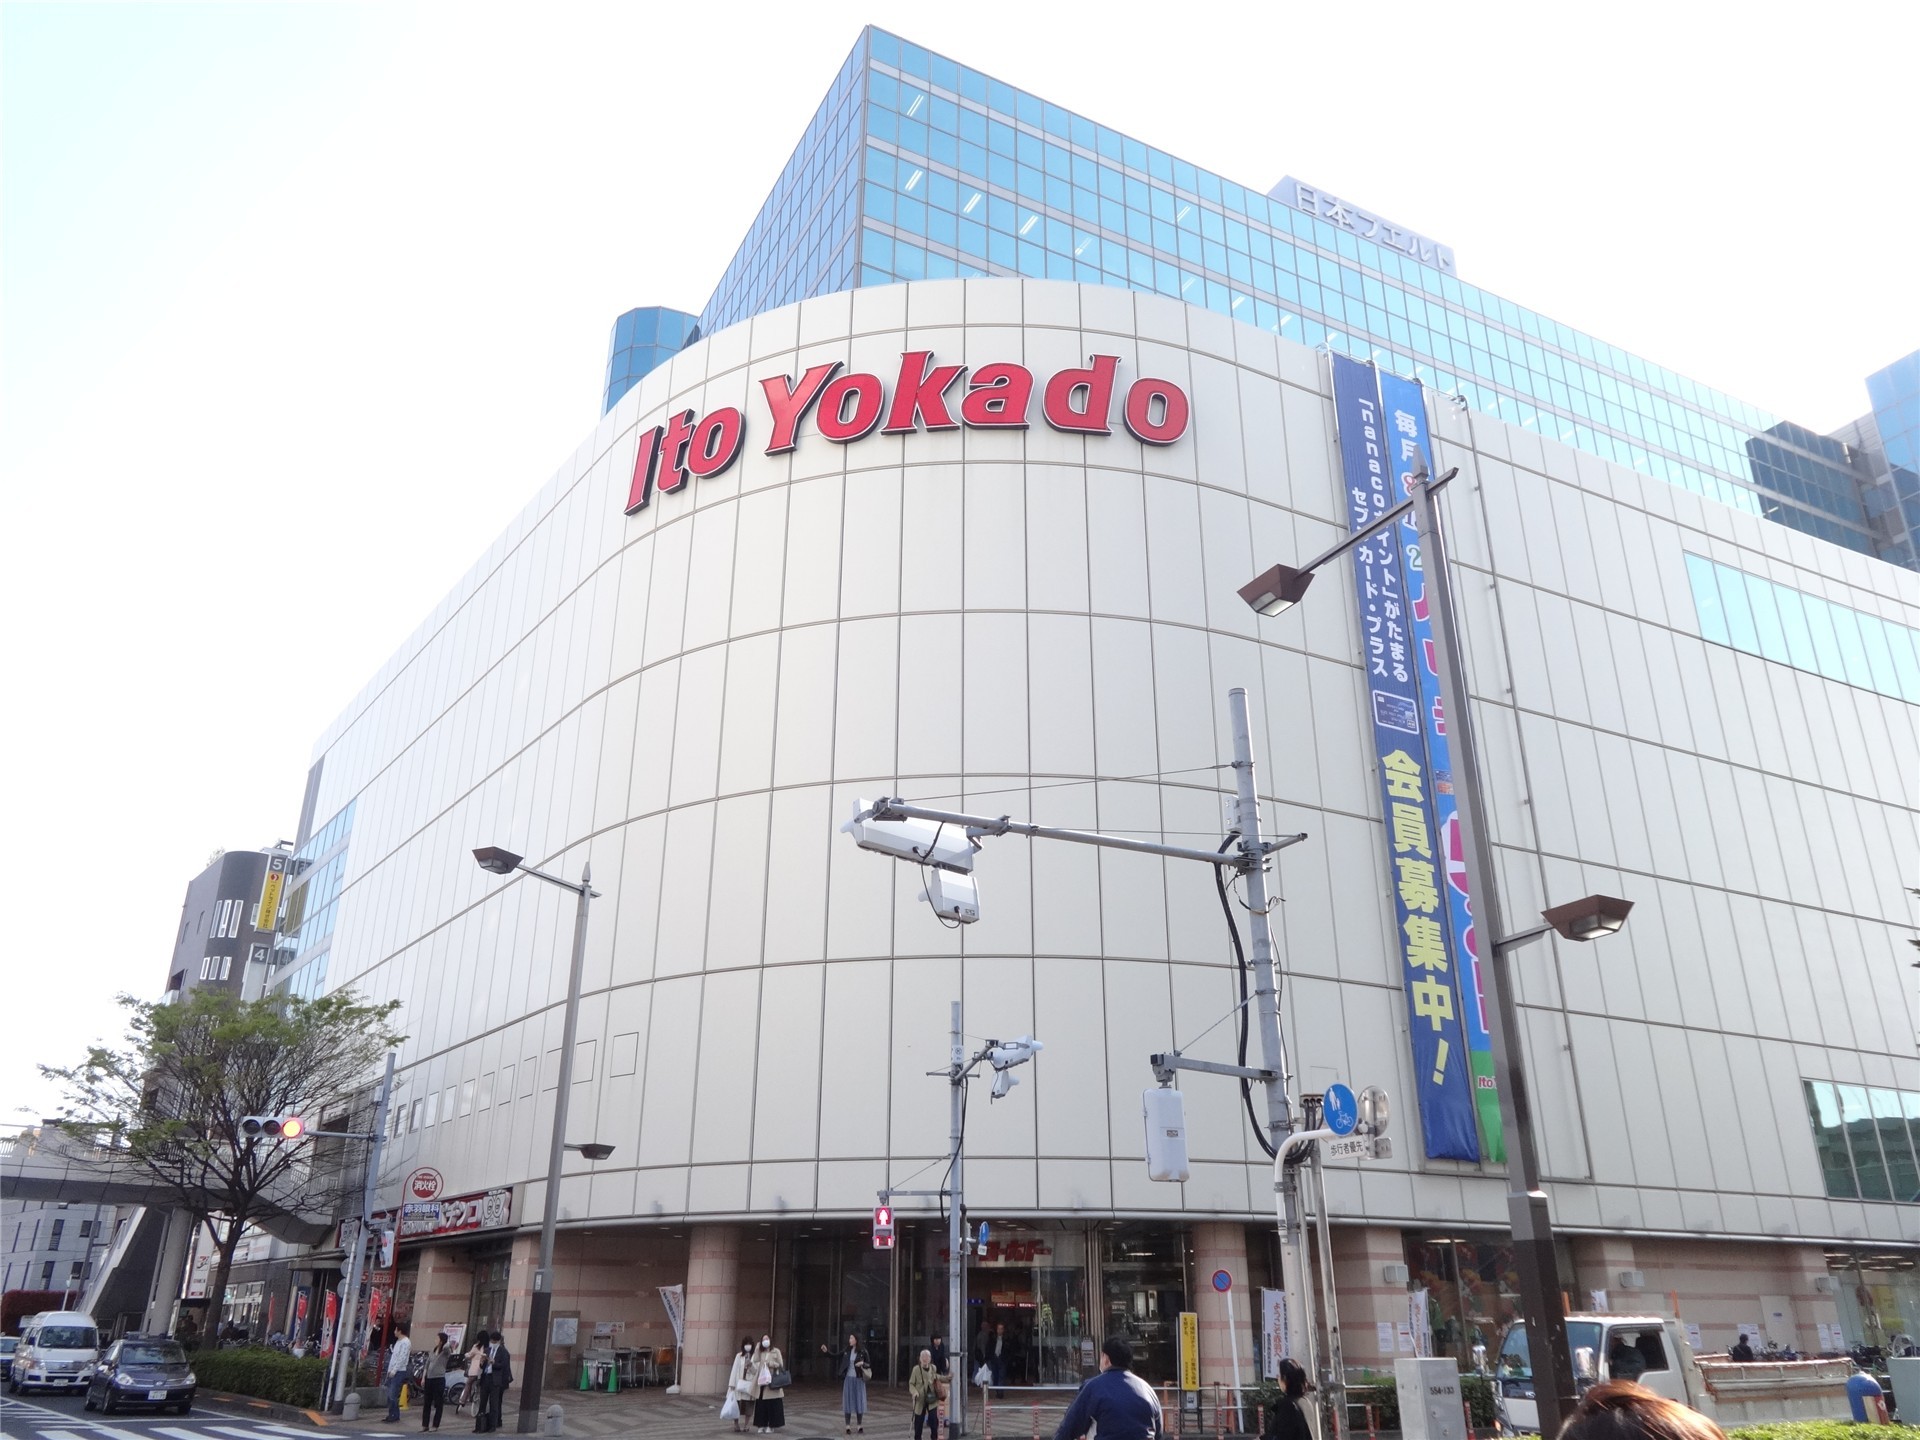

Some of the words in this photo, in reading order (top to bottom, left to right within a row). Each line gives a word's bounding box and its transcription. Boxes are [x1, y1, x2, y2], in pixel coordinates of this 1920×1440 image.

[624, 408, 746, 516] Ito
[759, 350, 1190, 456] Yokado
[1352, 487, 1388, 677] セブカード・プラス
[272, 859, 282, 870] 5
[254, 949, 265, 961] 4
[1330, 1141, 1363, 1156] 歩行者優先
[414, 1180, 436, 1191] 消火栓
[404, 1204, 439, 1213] 赤羽眼科
